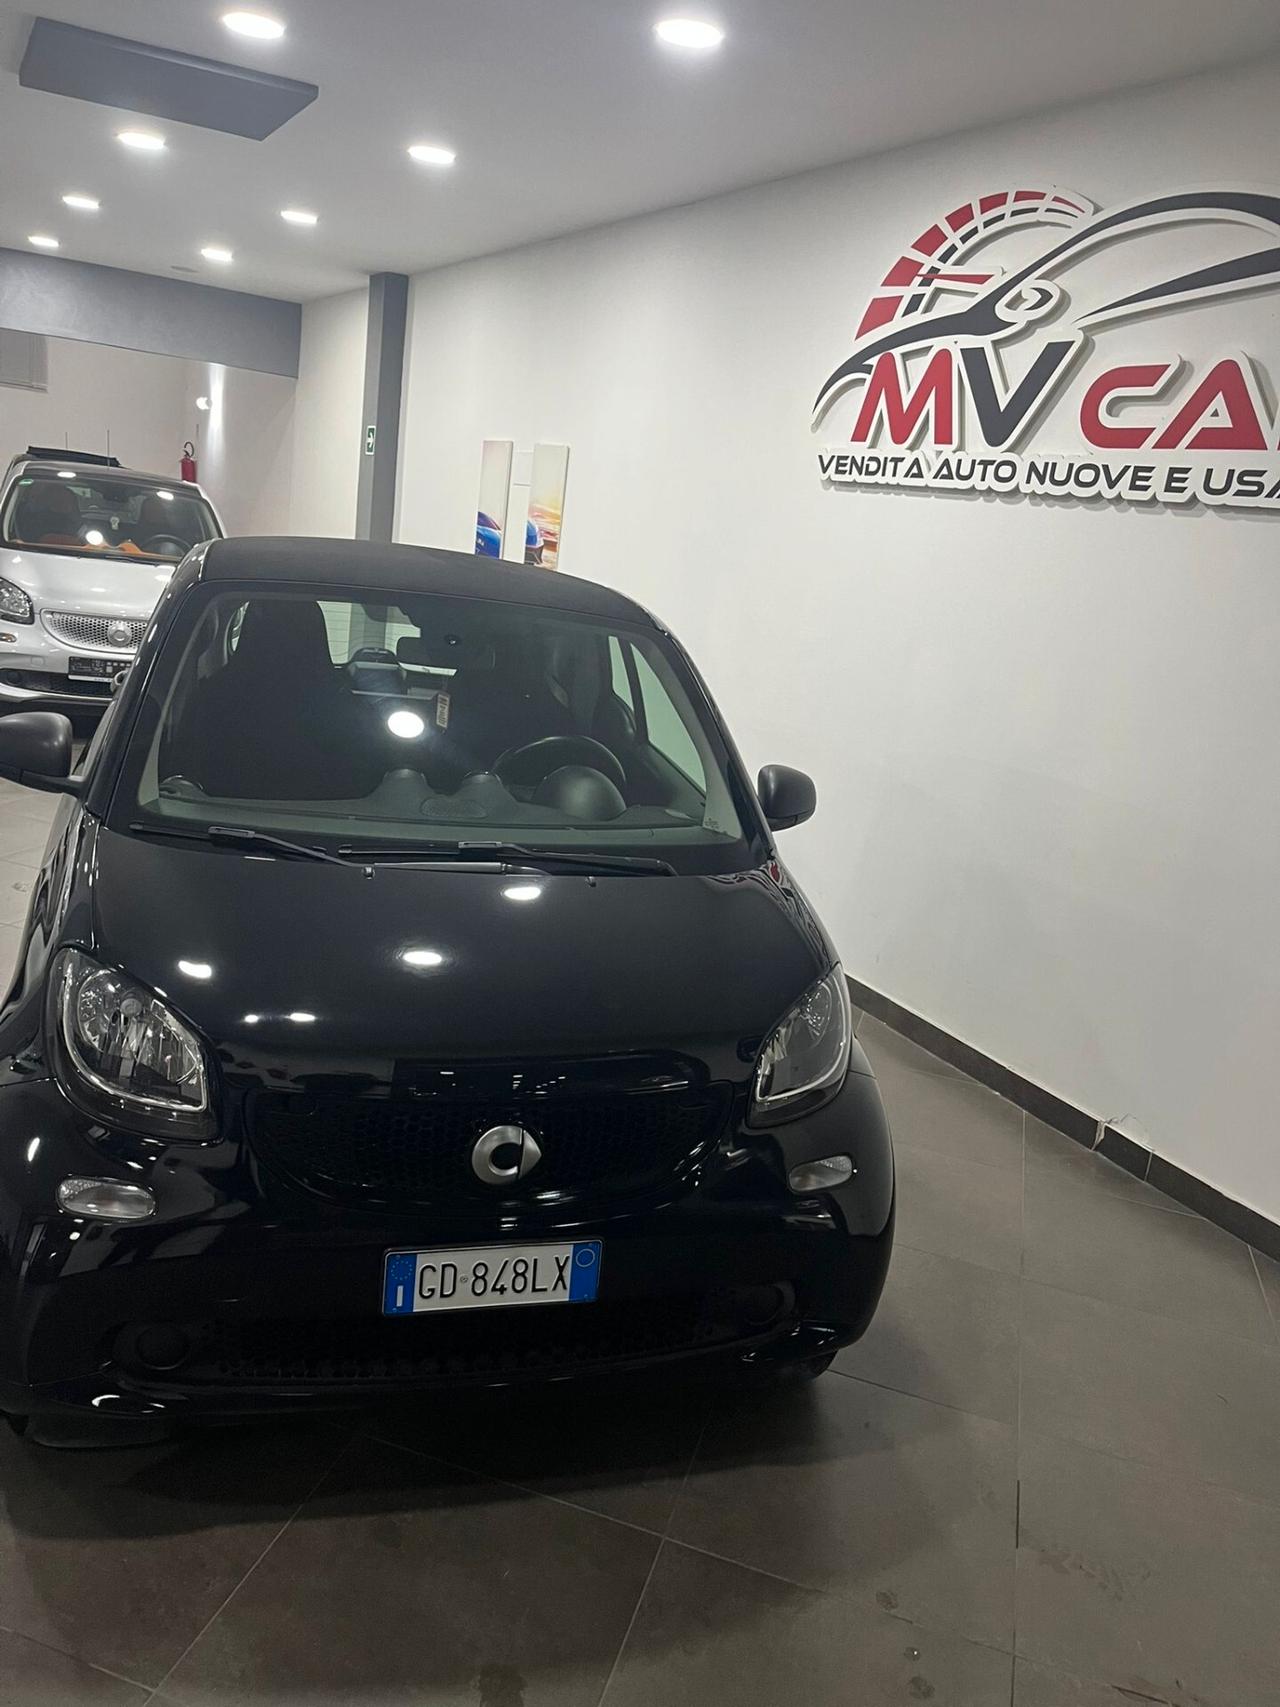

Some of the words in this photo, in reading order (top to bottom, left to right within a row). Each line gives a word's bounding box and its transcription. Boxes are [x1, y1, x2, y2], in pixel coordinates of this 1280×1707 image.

[1079, 359, 1280, 450] CA
[818, 454, 925, 479] VENDITA
[933, 457, 1018, 483] AUTO
[1025, 460, 1156, 492] NUOVE
[1164, 467, 1193, 493] E
